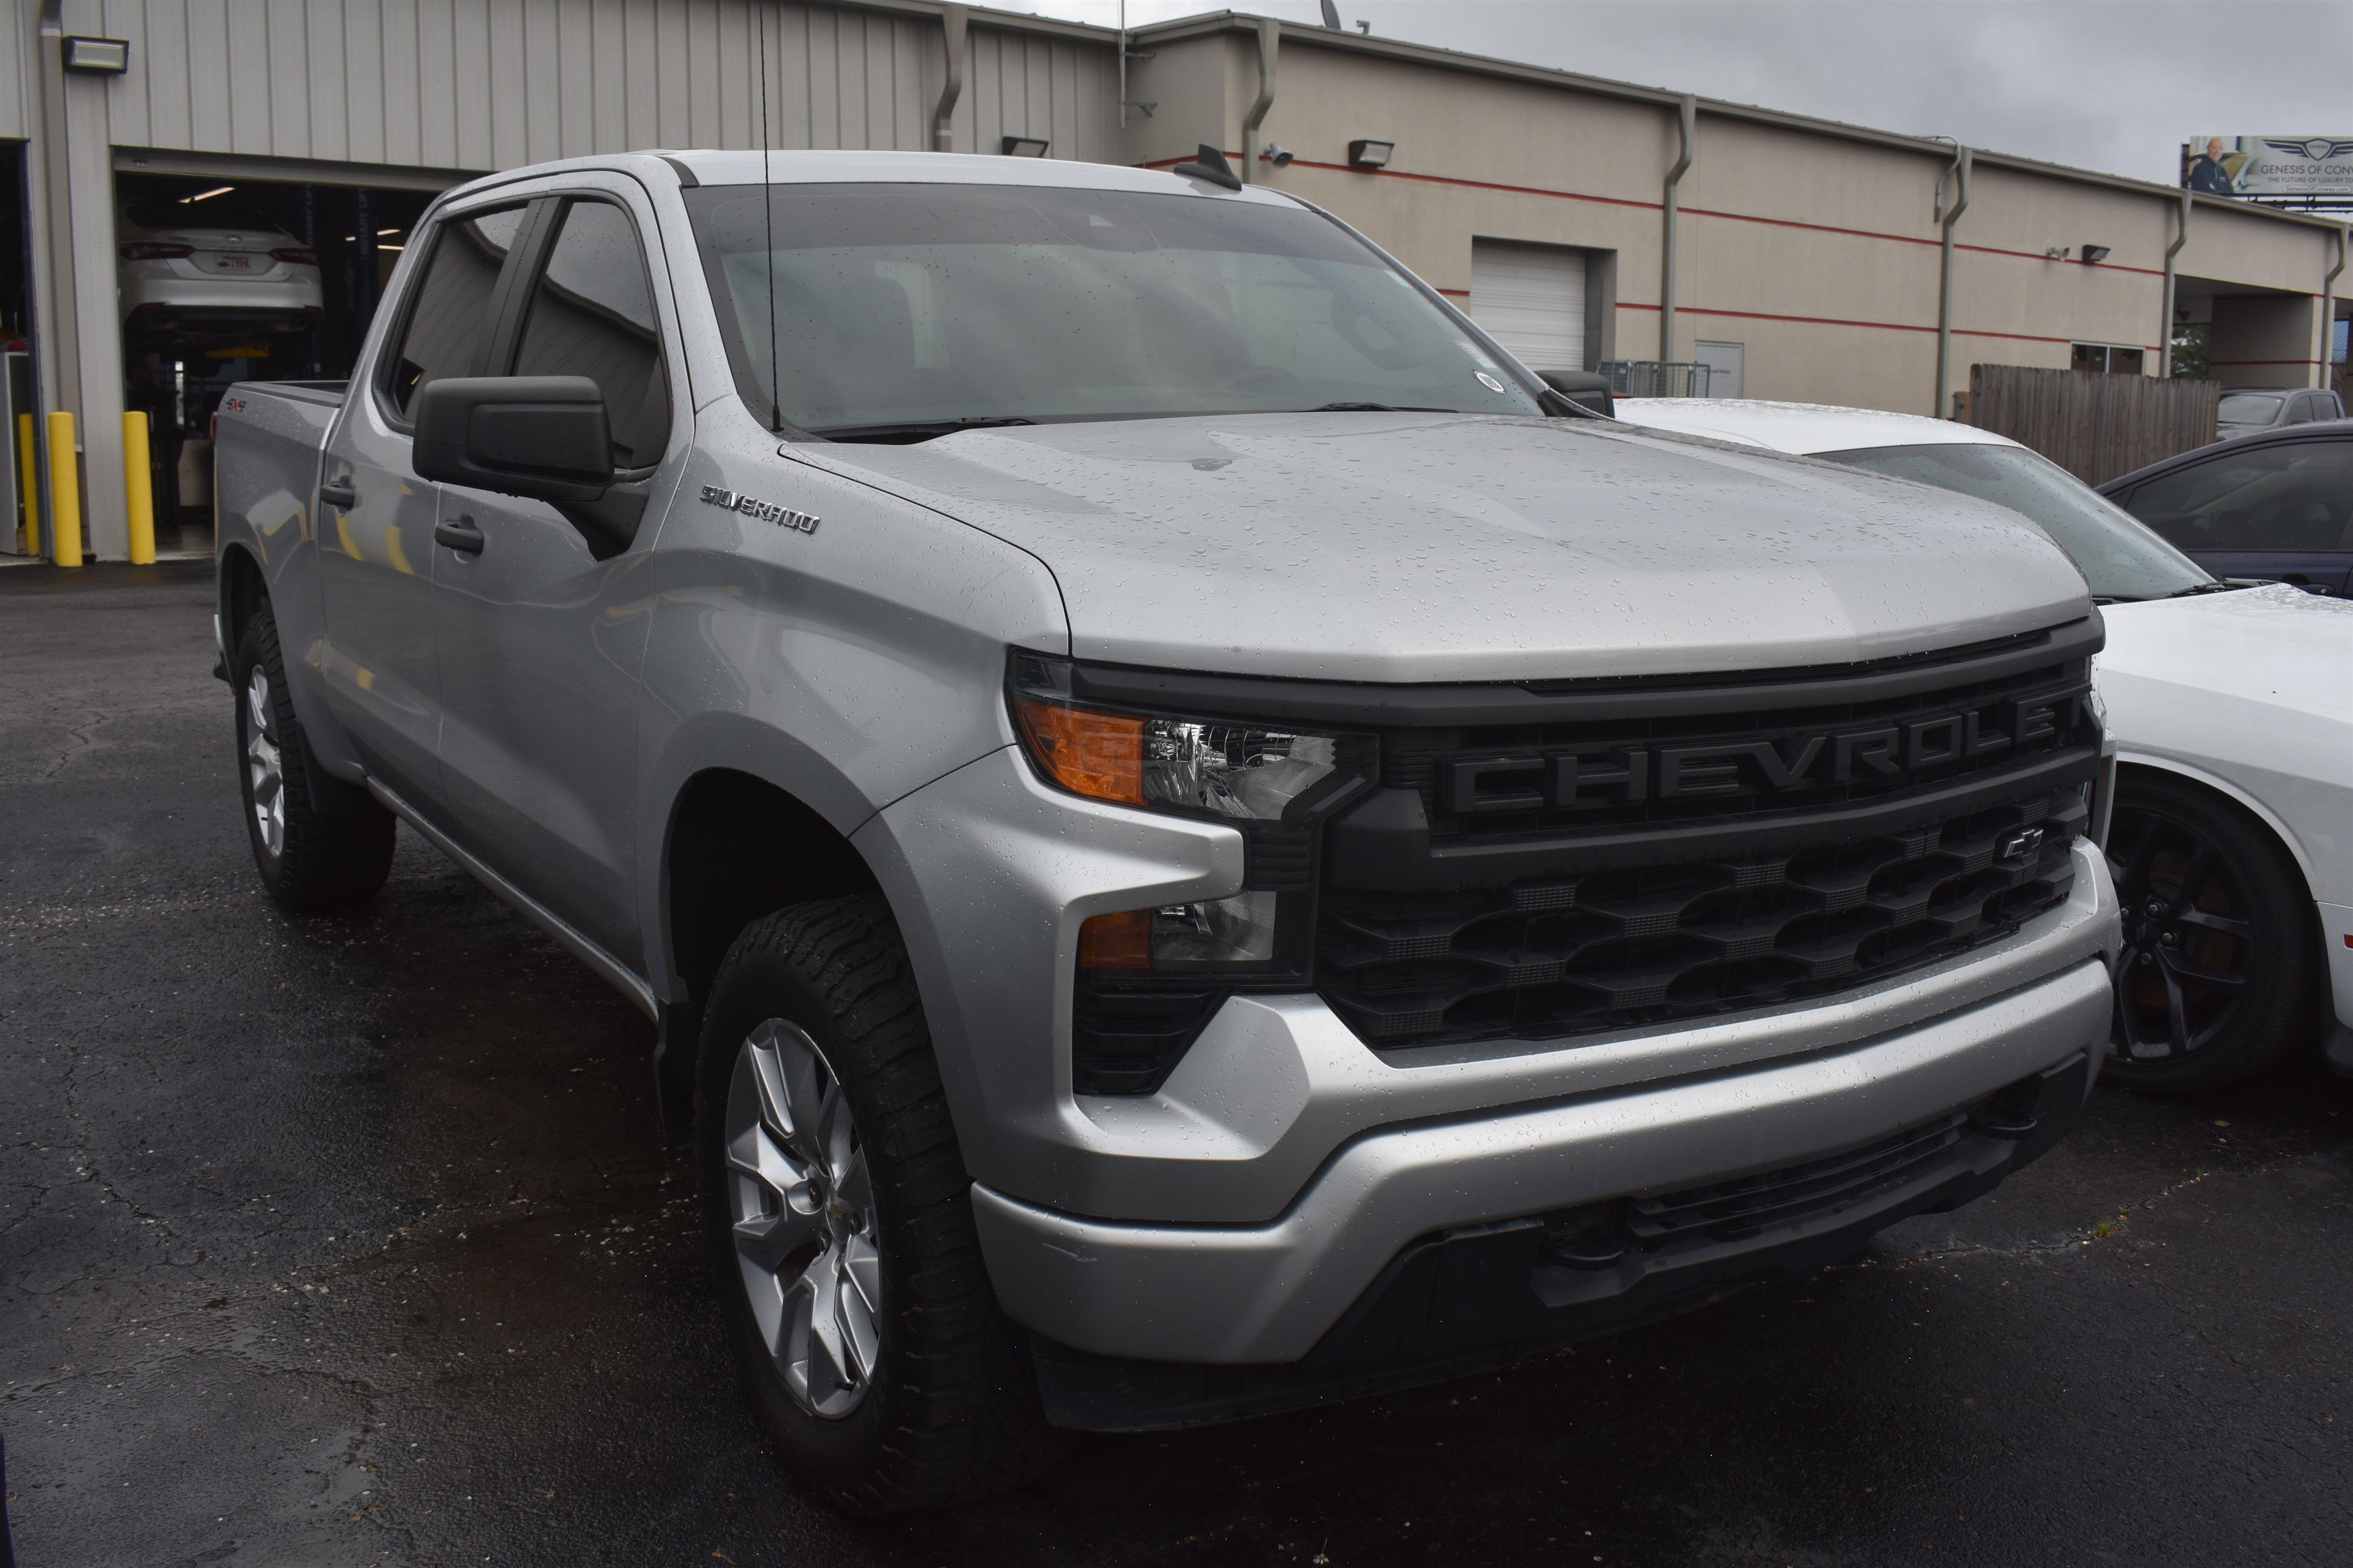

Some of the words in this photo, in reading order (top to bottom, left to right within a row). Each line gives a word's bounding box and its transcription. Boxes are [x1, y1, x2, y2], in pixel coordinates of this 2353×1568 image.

[2261, 165, 2305, 174] GENESIS
[2308, 165, 2321, 174] OF
[226, 398, 247, 413] 4X4
[699, 485, 821, 535] SILVERADO
[1445, 683, 2090, 813] CHEVROLET
